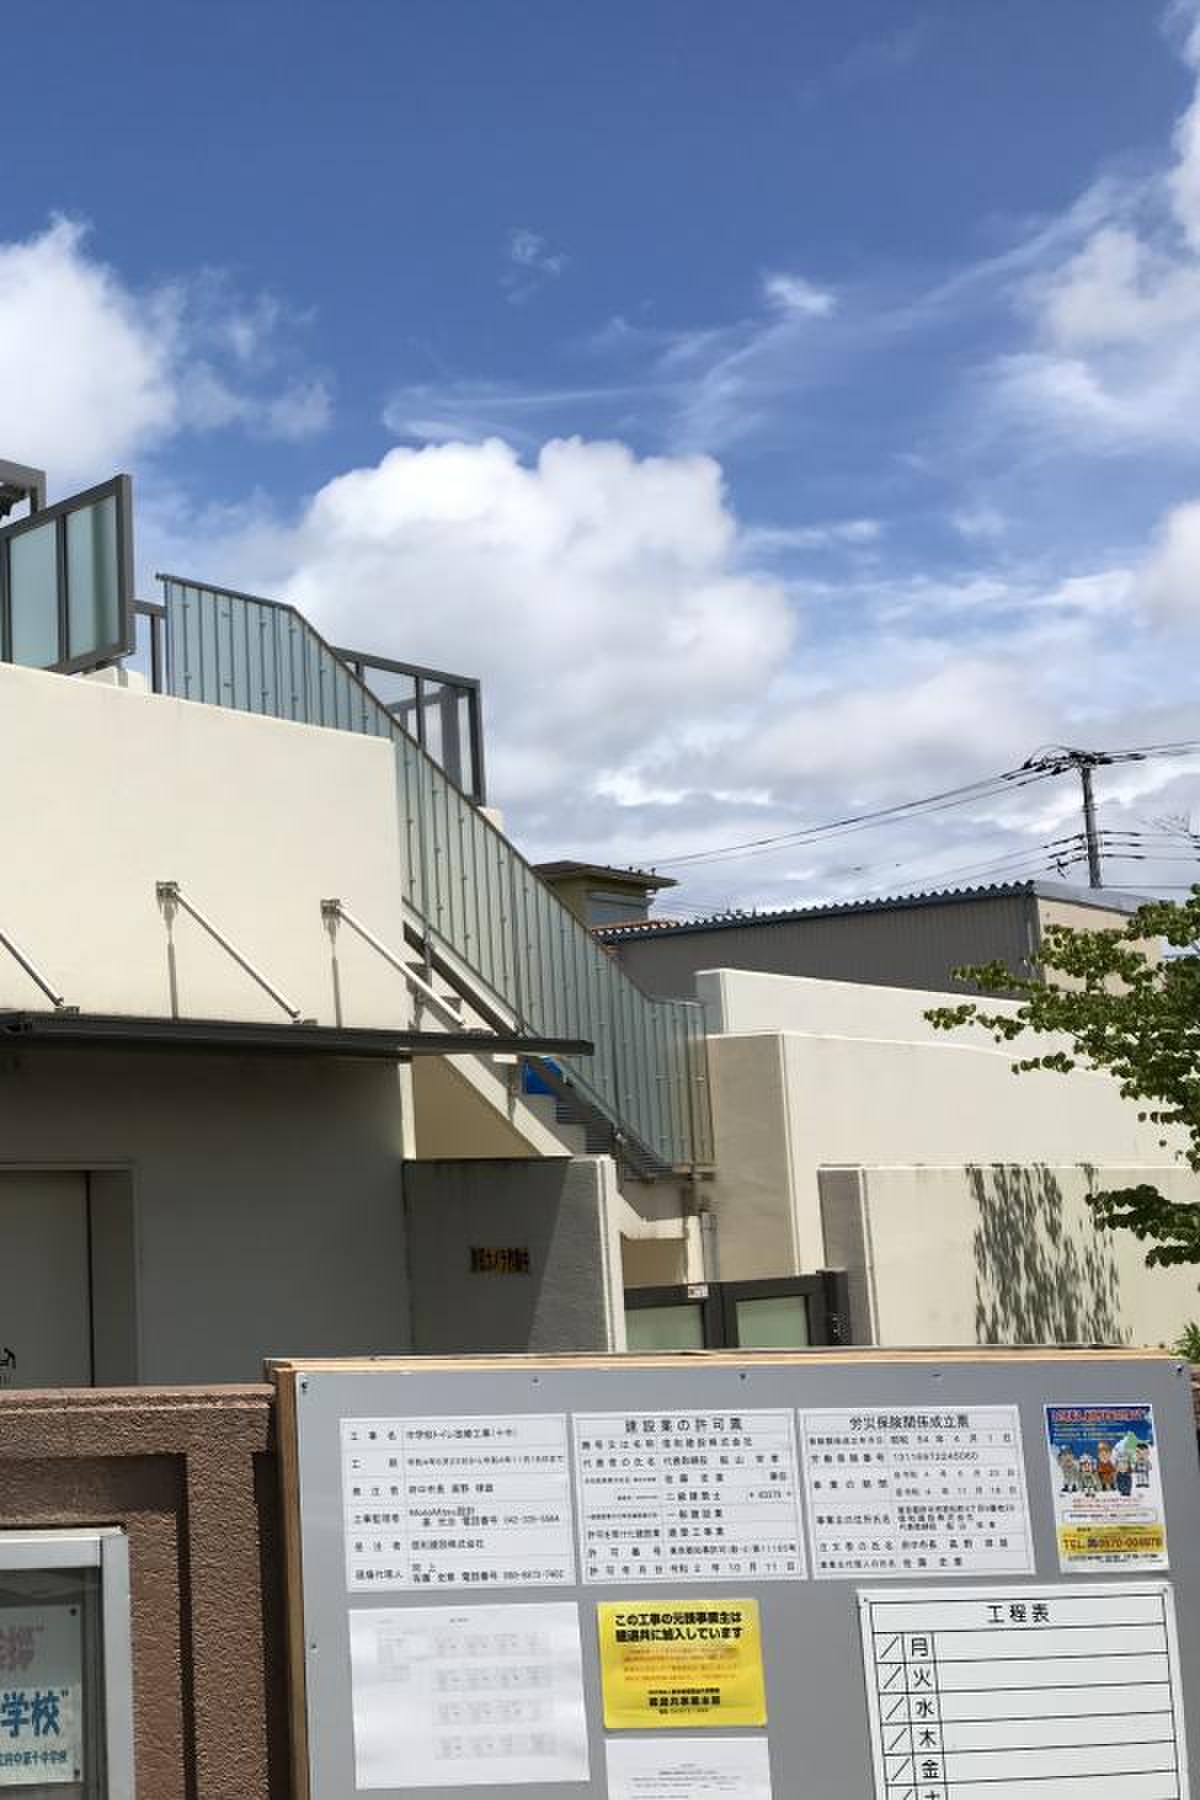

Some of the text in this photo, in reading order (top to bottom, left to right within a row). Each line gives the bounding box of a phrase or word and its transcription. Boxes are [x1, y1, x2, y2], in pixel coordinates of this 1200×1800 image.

[848, 1415, 970, 1430] 労災保険関係成立票
[987, 1603, 1051, 1624] 工程表
[910, 1637, 930, 1657] 月
[914, 1669, 933, 1688] 火
[916, 1700, 935, 1719] 水
[918, 1729, 938, 1748] 木
[921, 1759, 940, 1780] 金
